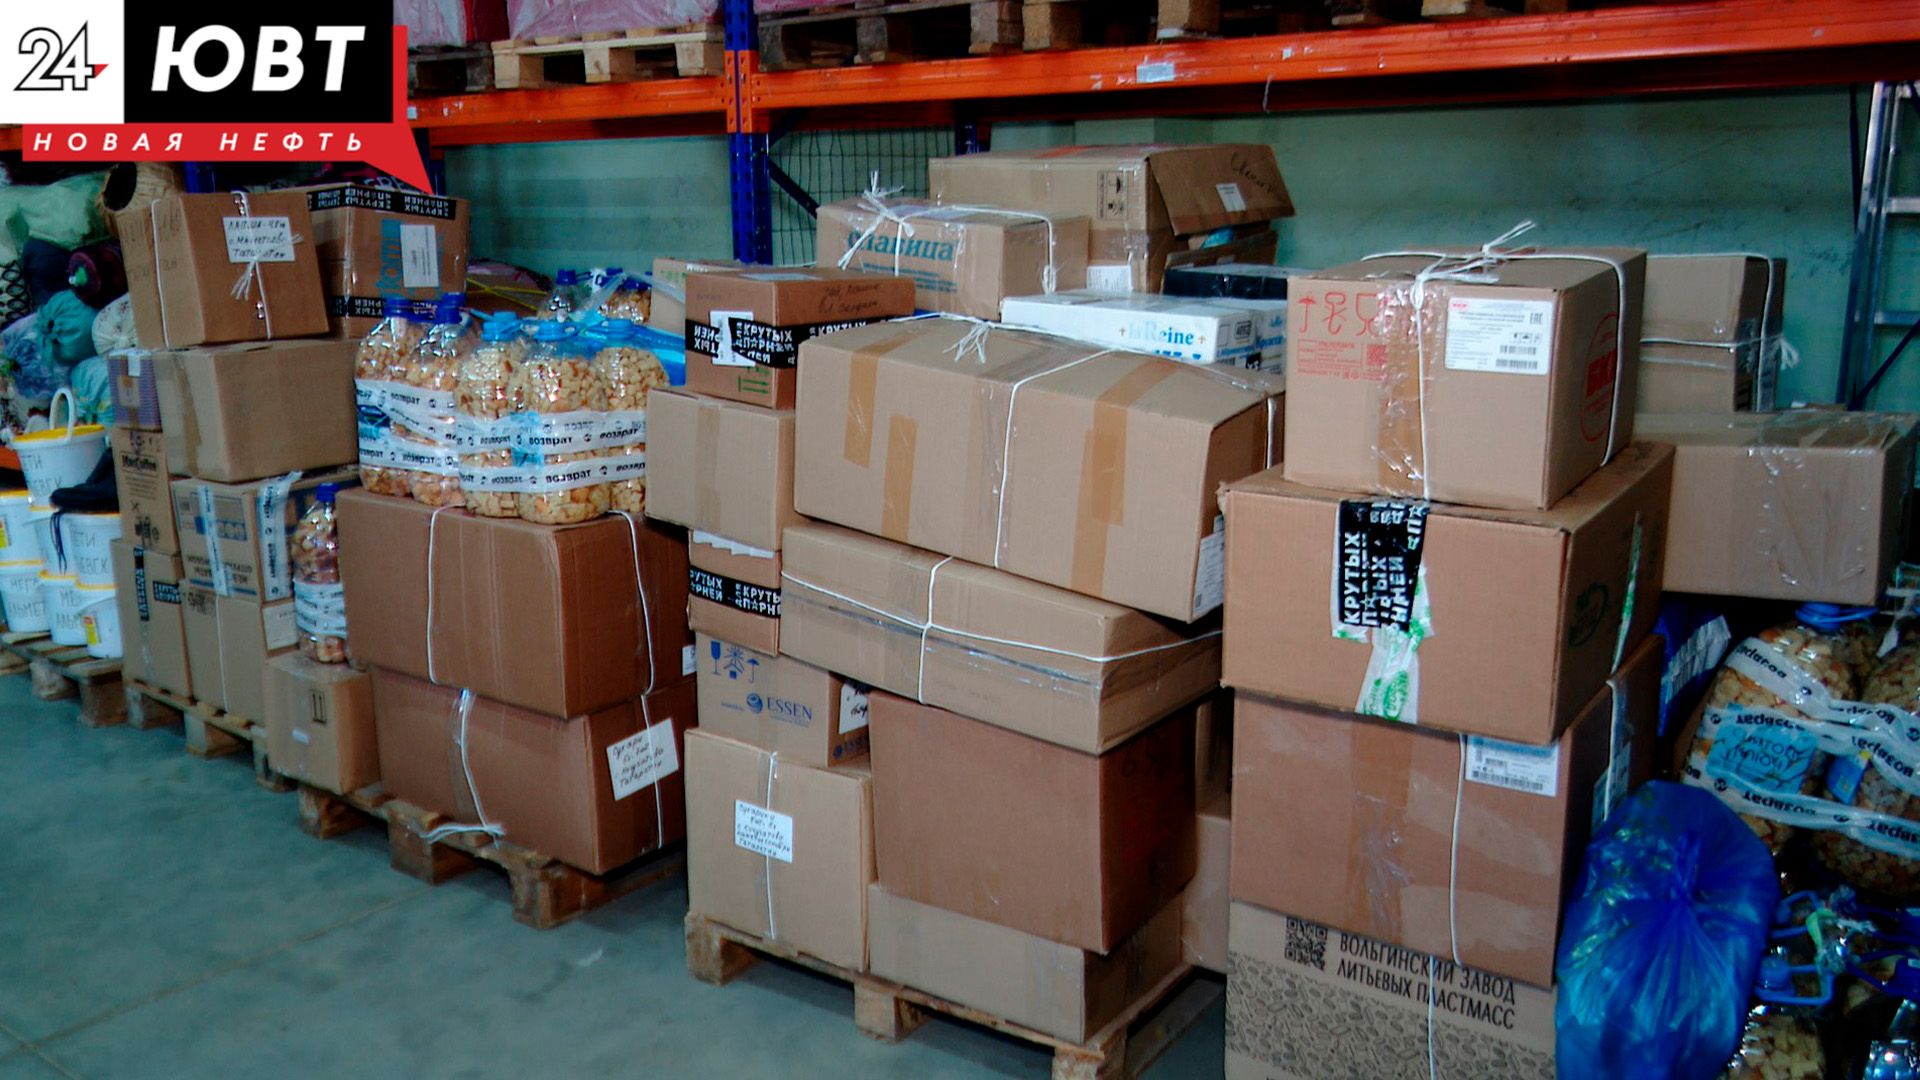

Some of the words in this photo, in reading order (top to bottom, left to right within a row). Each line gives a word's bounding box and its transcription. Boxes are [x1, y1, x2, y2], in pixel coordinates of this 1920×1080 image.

[743, 323, 793, 342] КРУТЫХ
[529, 436, 573, 447] возврат
[1344, 531, 1361, 625] КРУТЫХ
[767, 696, 813, 721] ESSEN
[1340, 933, 1455, 984] ВОЛЬГИНСКИЙ
[1460, 969, 1516, 1005] ЗАВОД
[1337, 959, 1412, 998] ЛИТЬЕВЫХ
[1417, 984, 1516, 1031] ПЛАСТМАСС
